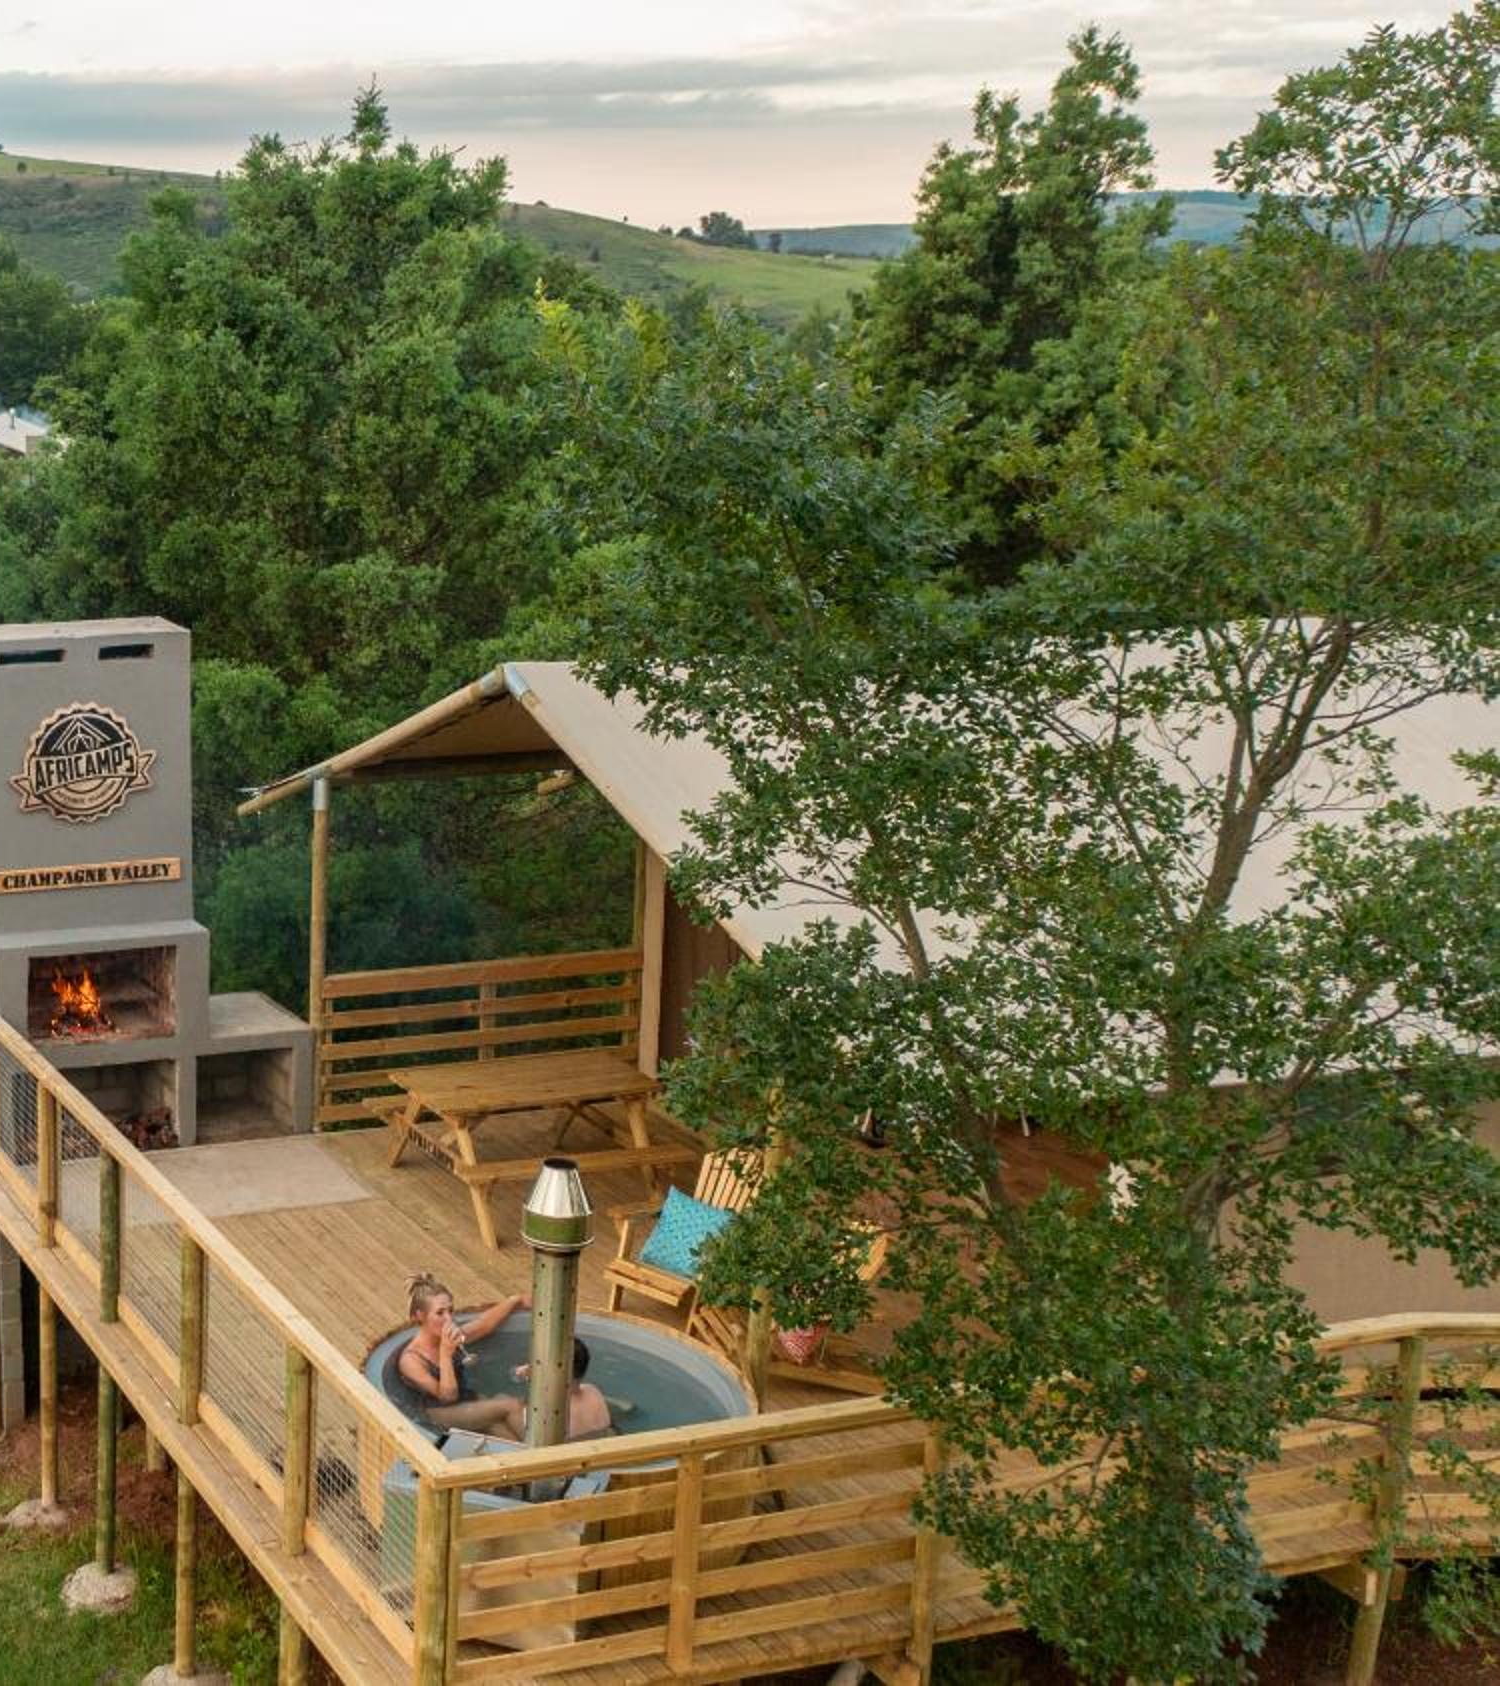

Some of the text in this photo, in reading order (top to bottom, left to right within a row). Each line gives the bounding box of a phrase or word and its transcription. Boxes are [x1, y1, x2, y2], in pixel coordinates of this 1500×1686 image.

[35, 743, 135, 791] AFRICAMPS
[3, 863, 171, 889] CHAMPAGNE VALLEY
